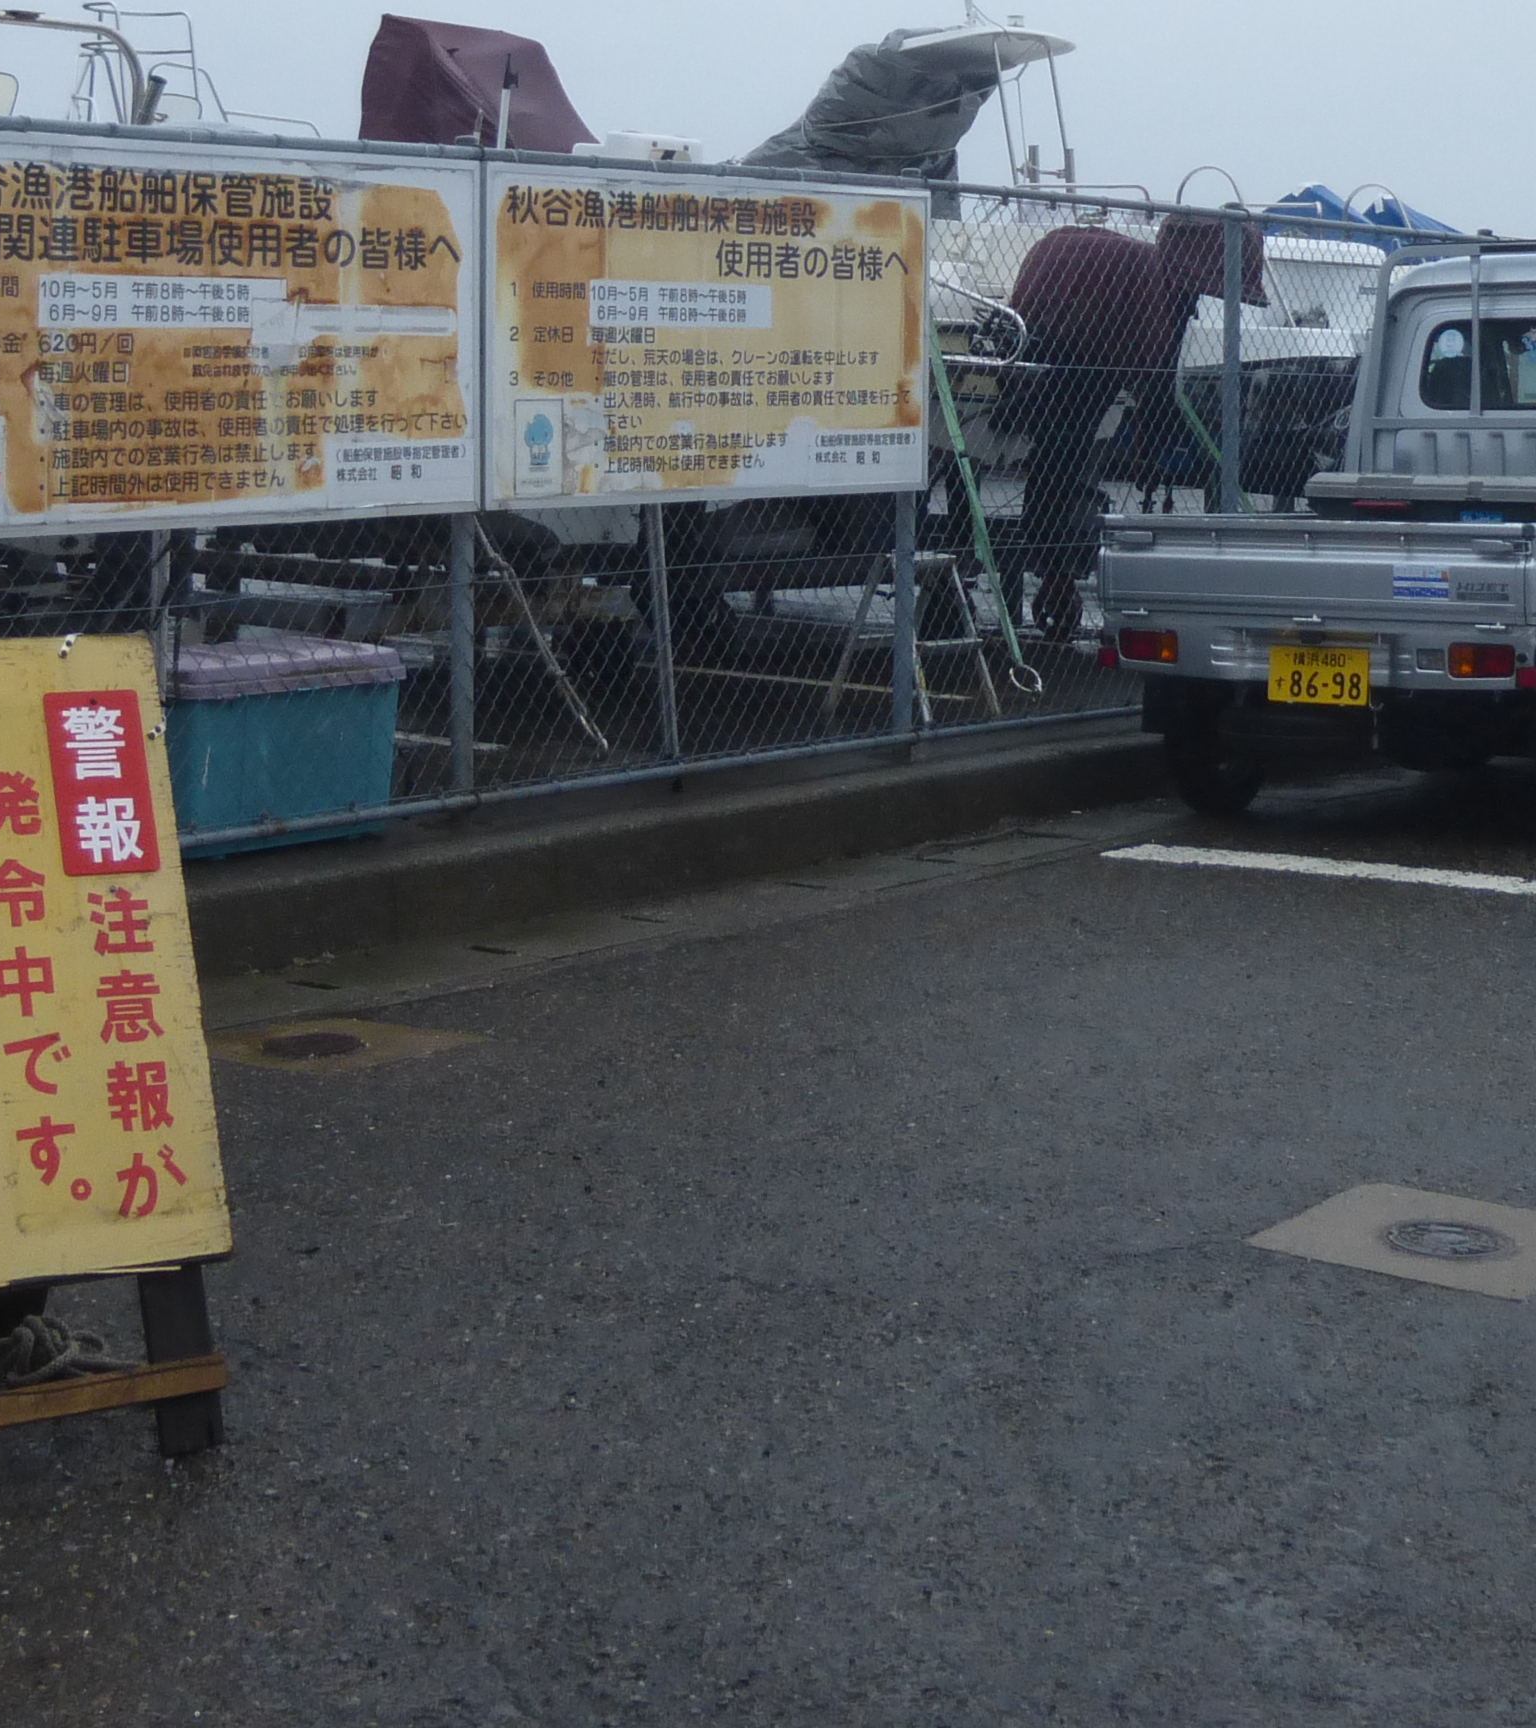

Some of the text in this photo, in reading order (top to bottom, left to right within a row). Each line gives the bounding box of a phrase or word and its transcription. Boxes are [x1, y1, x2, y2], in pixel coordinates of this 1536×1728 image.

[507, 185, 817, 238] 秋谷漁港船舶保管施設
[716, 241, 909, 281] 使用者の皆様へ
[510, 282, 518, 297] 1
[532, 282, 586, 299] 使用時間
[510, 326, 656, 344] 2 定休日 毎週火曜日
[39, 361, 129, 383] 毎週火曜日
[510, 371, 520, 386] 3
[533, 371, 574, 387] その他
[604, 414, 643, 430] 下さい
[815, 450, 848, 464] 株式会社
[336, 468, 378, 483] 株式会社
[1289, 669, 1362, 701] 86-98
